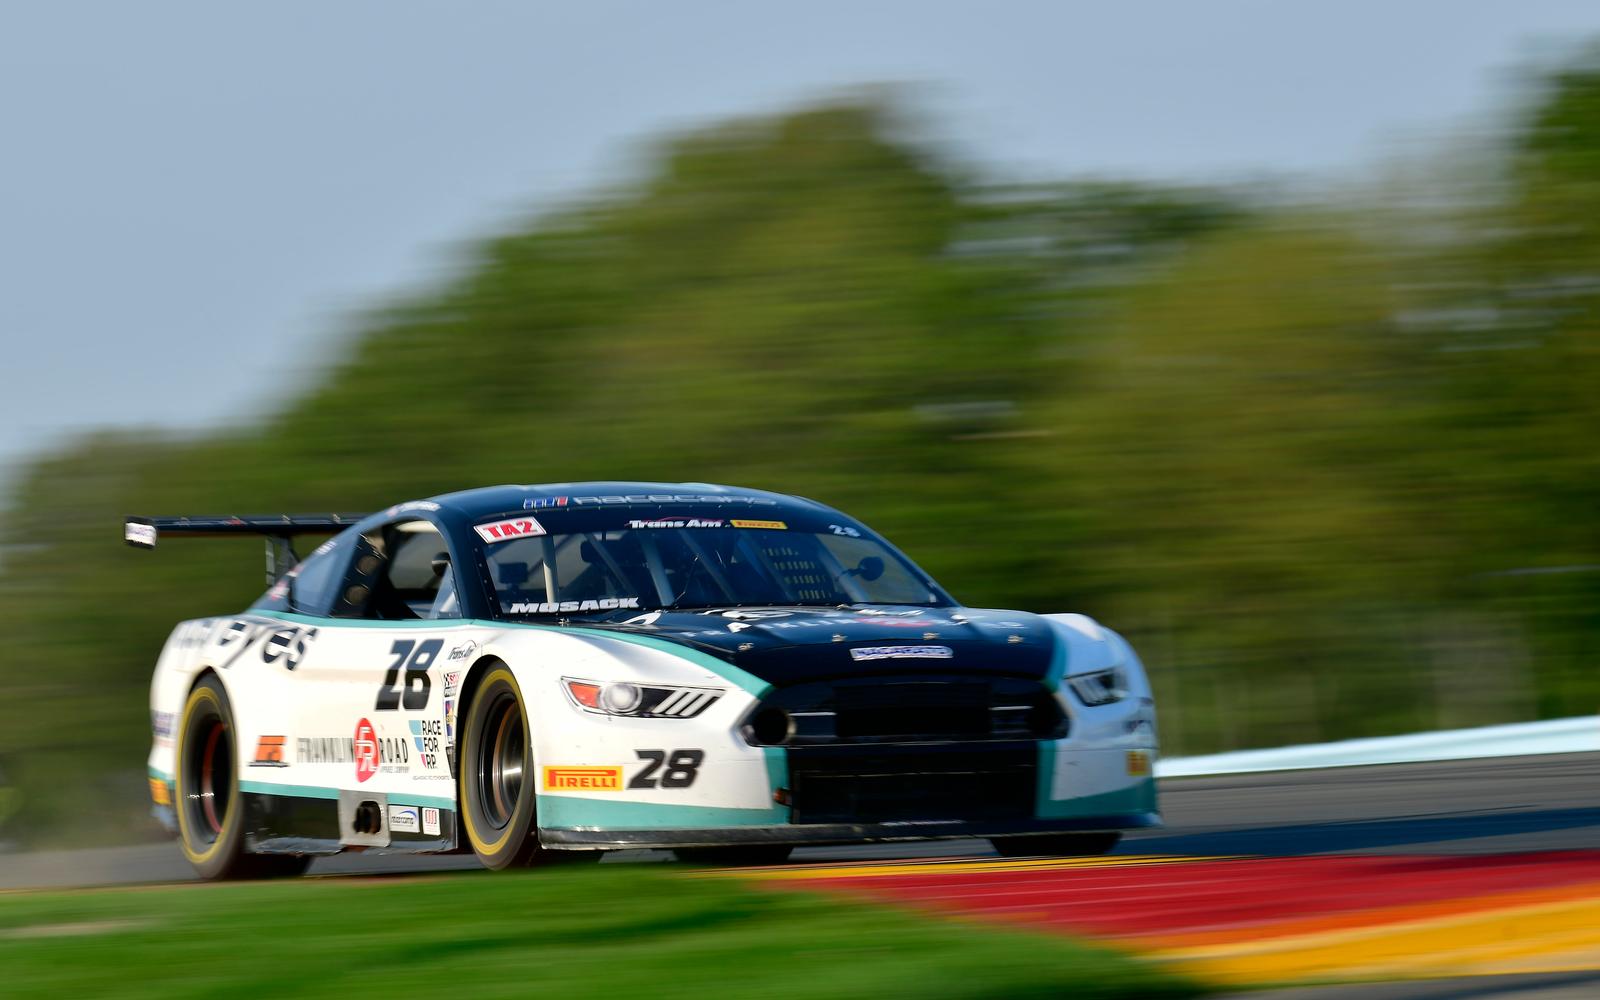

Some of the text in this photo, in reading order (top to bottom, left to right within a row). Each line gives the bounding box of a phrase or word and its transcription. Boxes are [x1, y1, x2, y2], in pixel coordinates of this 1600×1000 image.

[484, 520, 536, 540] TA2
[628, 519, 723, 529] Trans Am
[828, 524, 861, 538] 28
[509, 597, 640, 614] MOSACK
[219, 619, 319, 671] eyes
[375, 638, 445, 710] 28
[421, 719, 442, 736] RACE
[377, 737, 409, 763] ROAD
[423, 736, 440, 753] FOR
[548, 769, 617, 788] PIRELLI
[626, 748, 706, 790] 28
